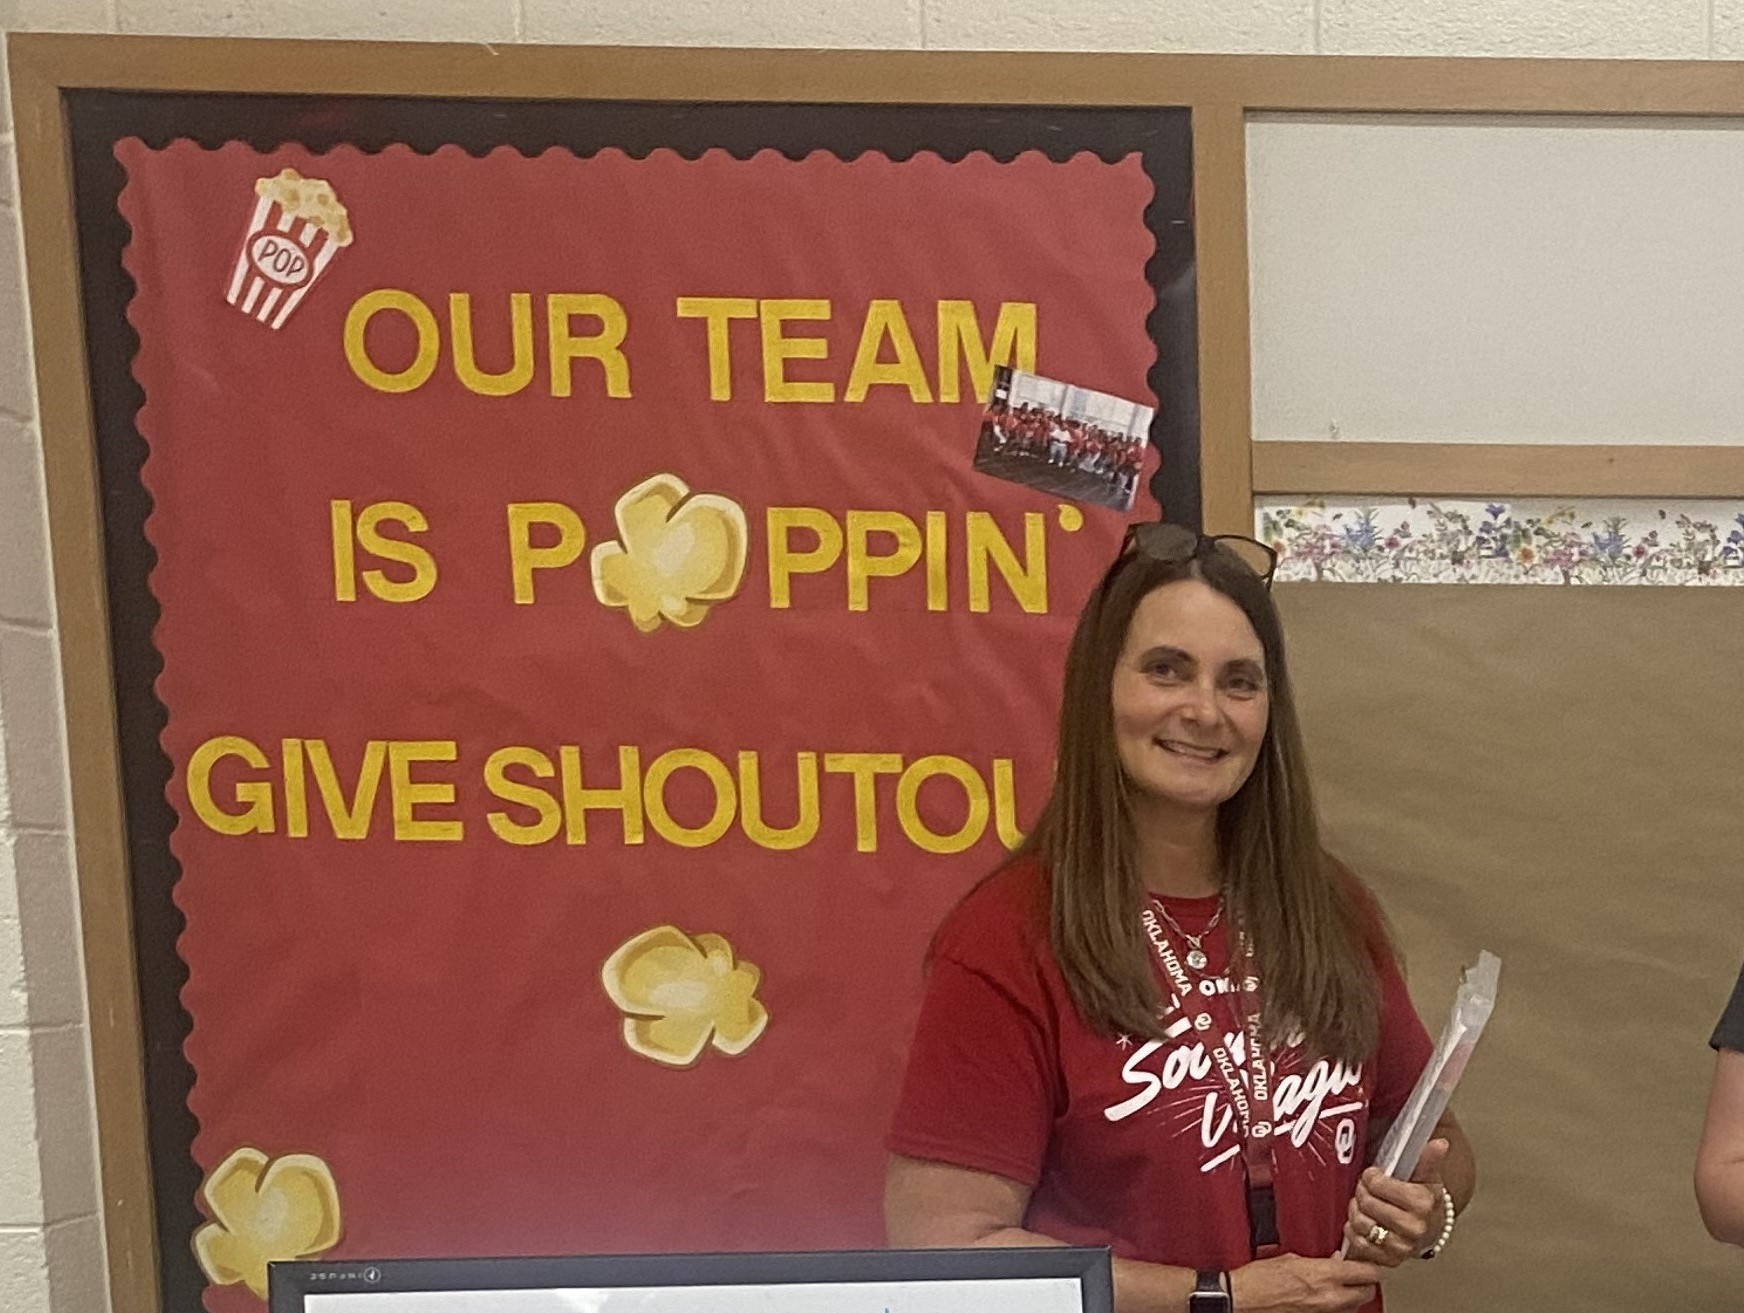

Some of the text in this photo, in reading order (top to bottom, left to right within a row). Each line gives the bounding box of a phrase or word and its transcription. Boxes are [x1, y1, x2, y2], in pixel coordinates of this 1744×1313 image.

[258, 240, 304, 277] POP
[343, 288, 1037, 404] OUR TEAM
[331, 499, 438, 604] IS
[186, 735, 464, 842] GIVE
